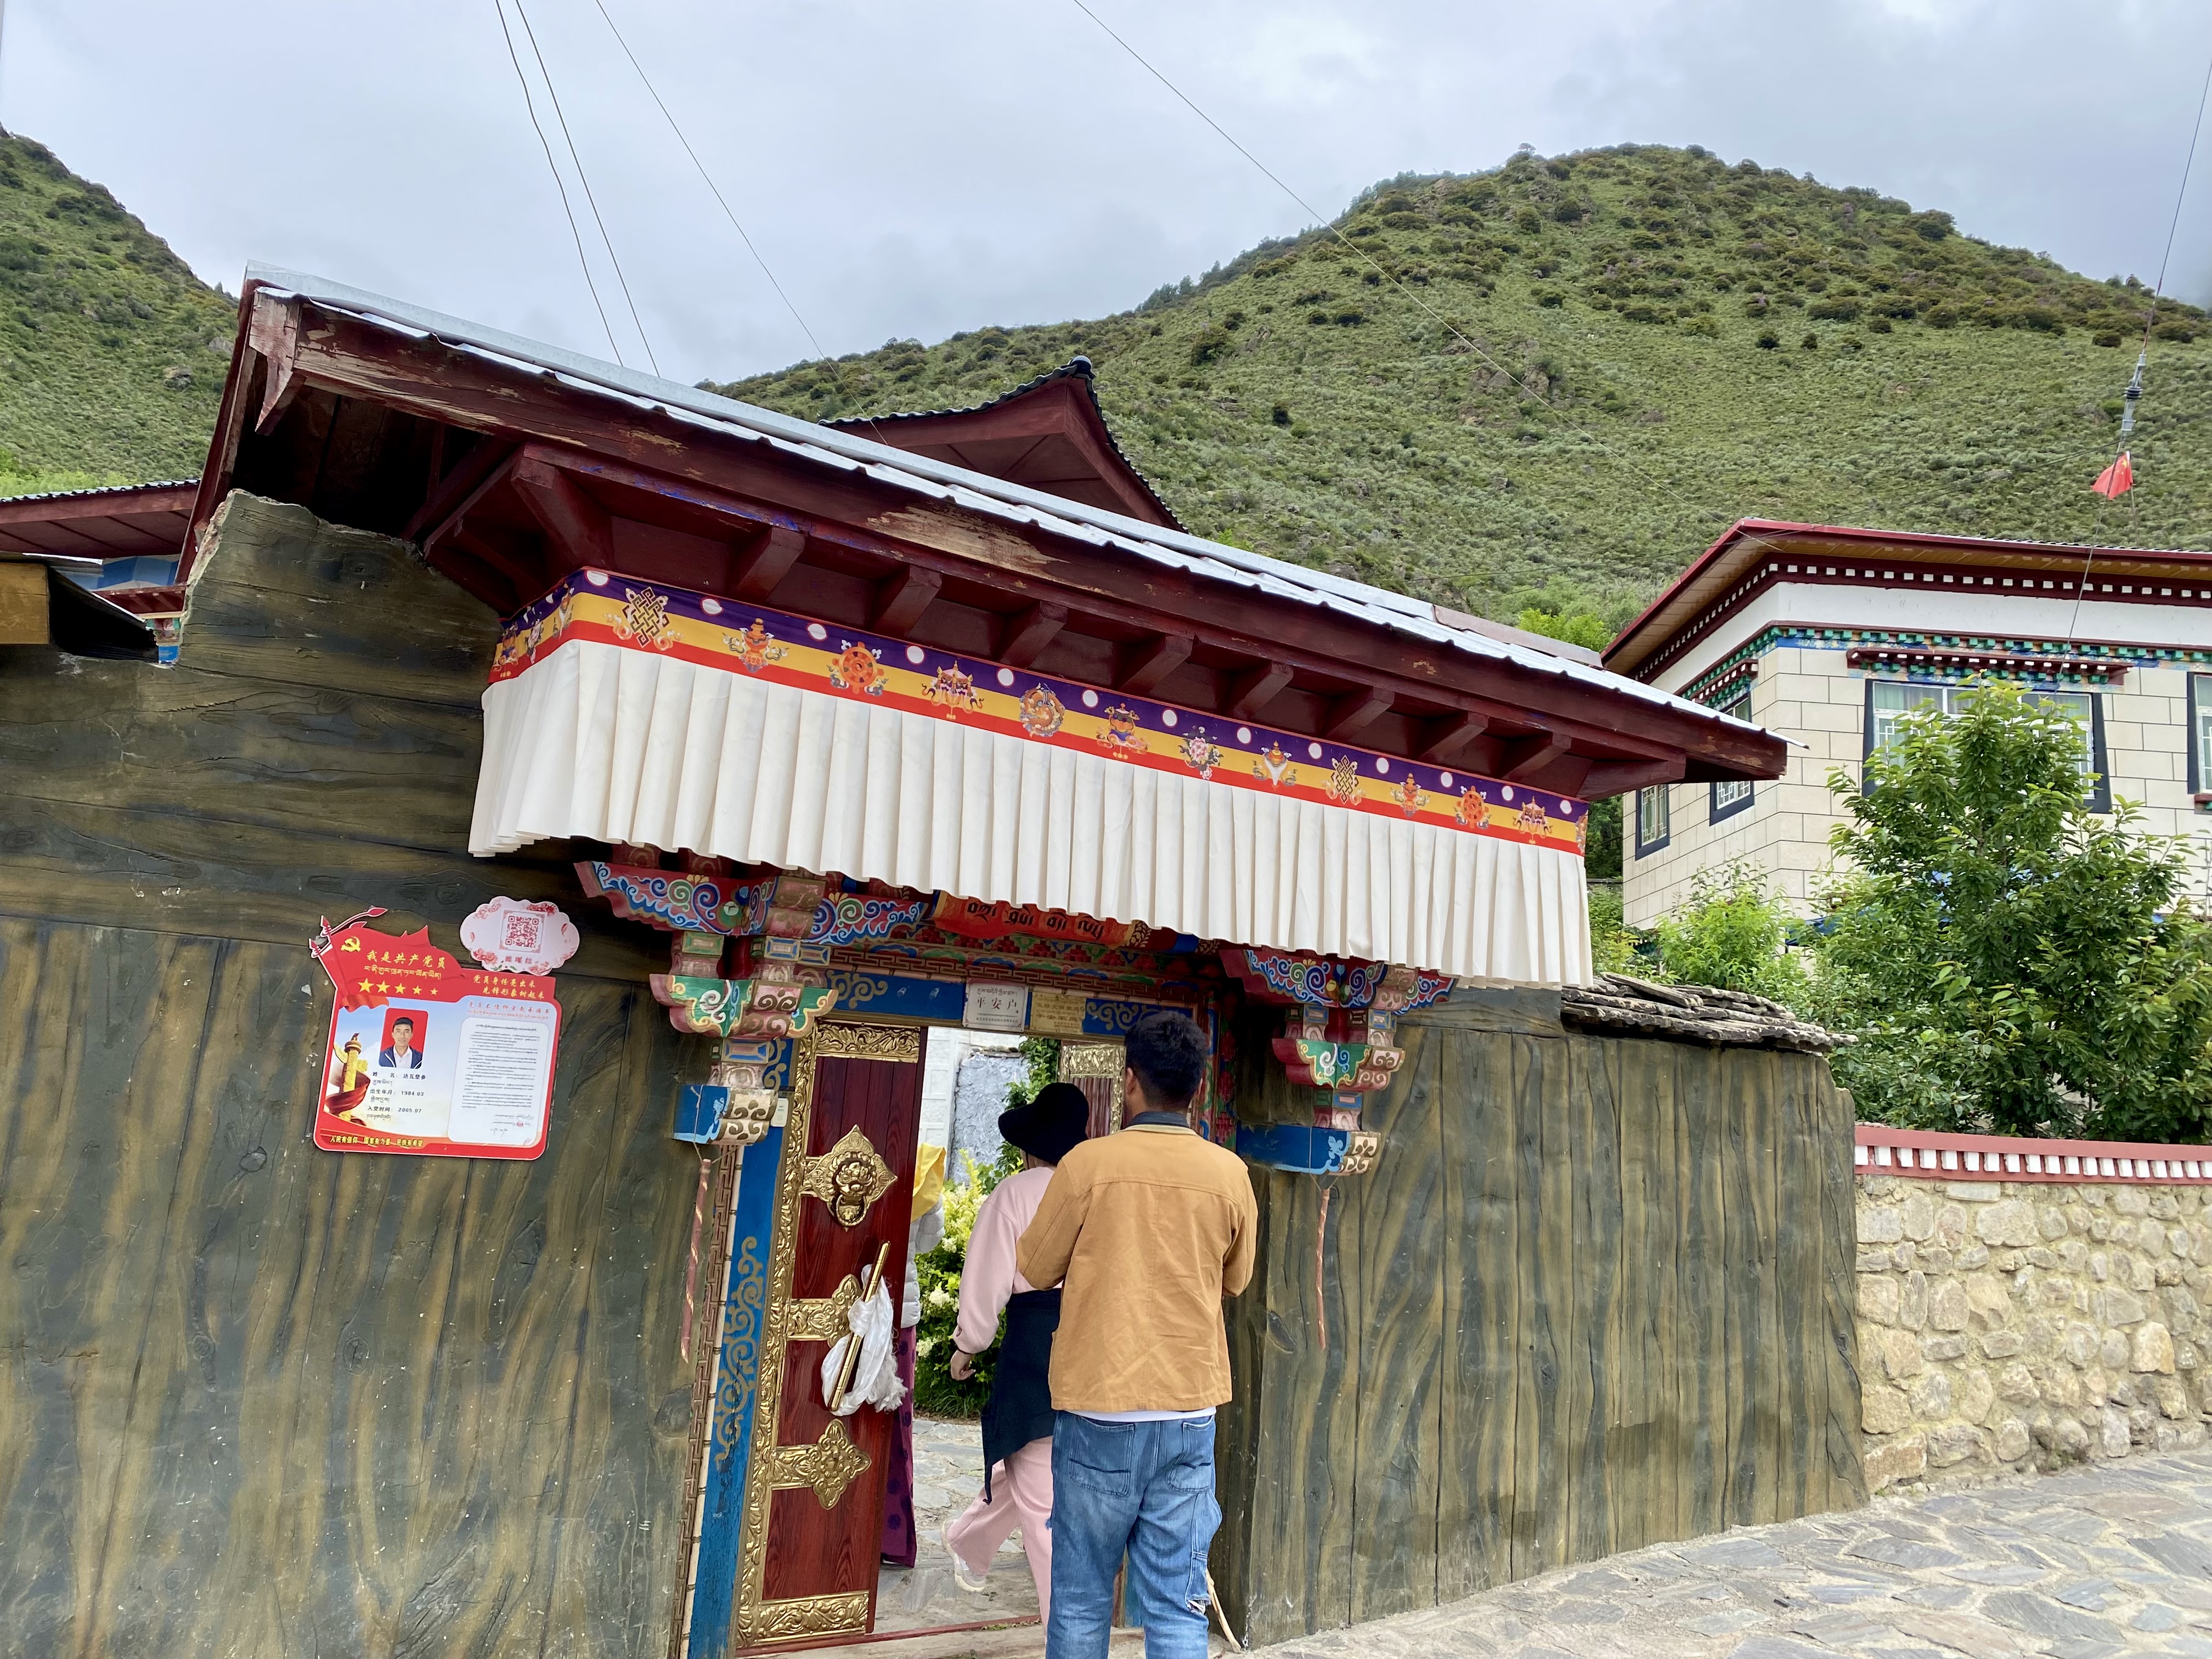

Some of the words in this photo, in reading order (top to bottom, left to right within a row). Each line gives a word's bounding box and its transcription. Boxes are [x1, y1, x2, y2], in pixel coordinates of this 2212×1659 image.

[366, 950, 445, 969] 我是共产党员
[473, 974, 535, 988] 党员身份亮出来
[482, 986, 545, 1000] 先锋形象树起来
[977, 997, 1017, 1010] 平安户
[330, 1135, 358, 1143] 人民有信仰
[363, 1137, 391, 1146] 国家有力量
[396, 1138, 424, 1147] 民族有希望
